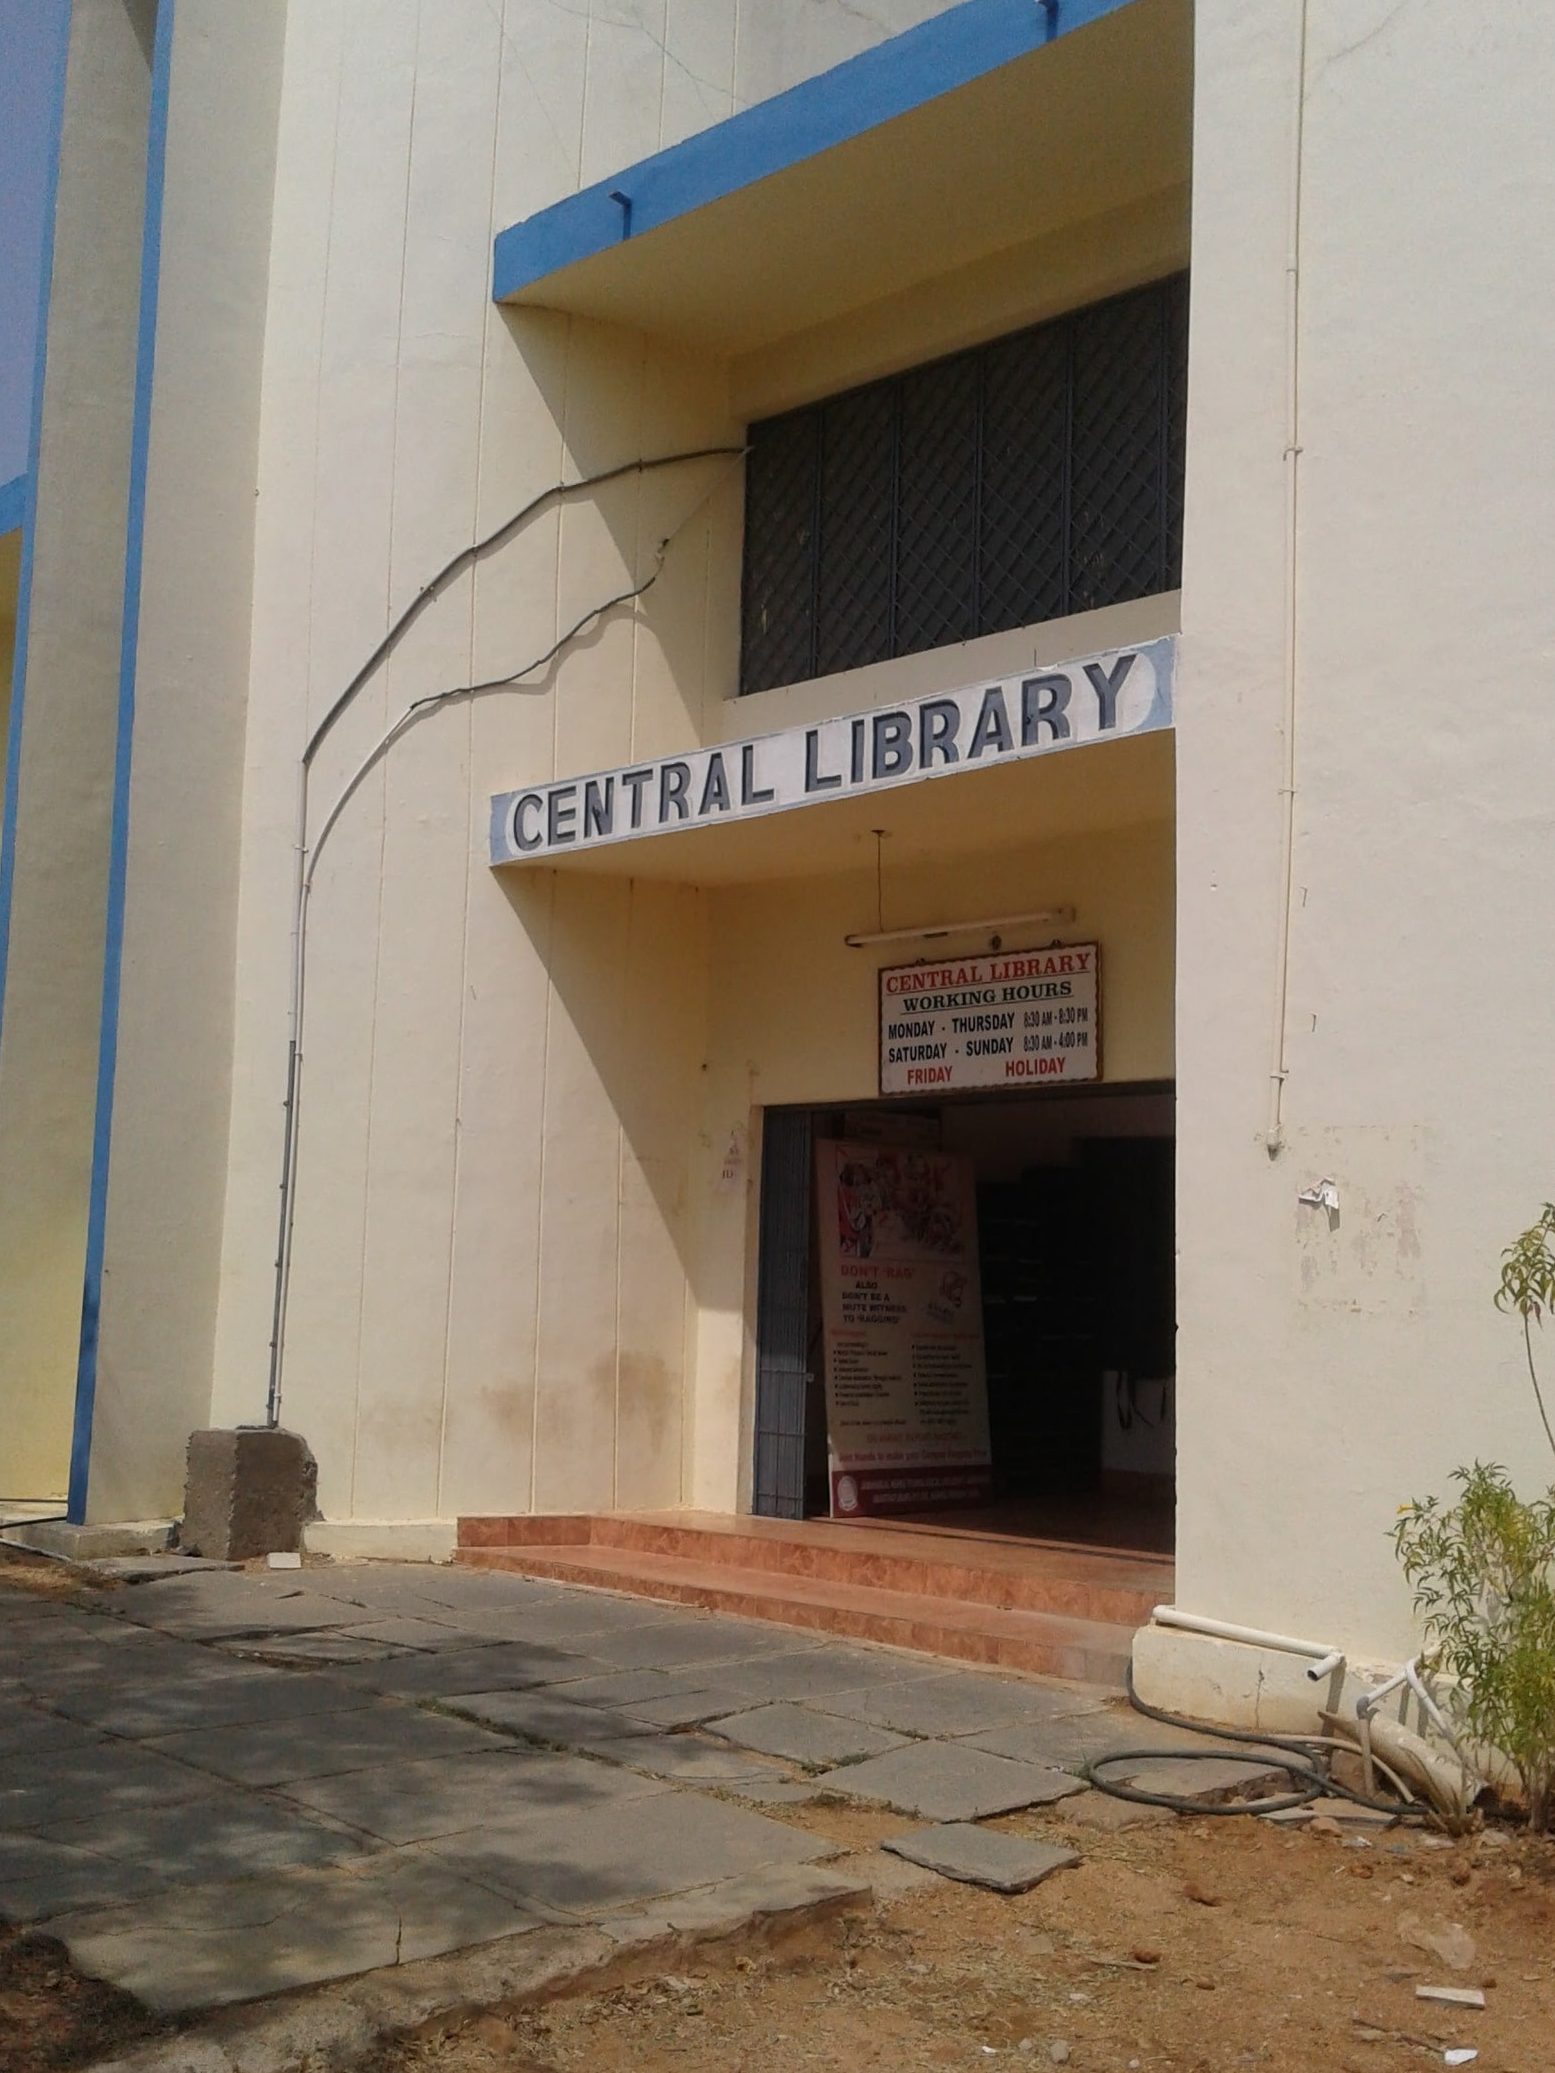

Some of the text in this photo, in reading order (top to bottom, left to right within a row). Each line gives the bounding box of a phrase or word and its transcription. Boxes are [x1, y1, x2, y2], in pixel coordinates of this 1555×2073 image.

[513, 654, 1136, 852] CENTRAL LIBRARY
[886, 953, 1091, 993] CENTRAL LIBRARY
[903, 981, 1072, 1012] WORKING HOURS
[888, 1020, 936, 1040] MONDAY
[952, 1012, 1016, 1034] THURSDAY
[1023, 1011, 1041, 1028] 8:30
[1041, 1010, 1053, 1026] AM
[1077, 1006, 1089, 1022] PM
[888, 1042, 948, 1063] SATURDAY
[966, 1036, 1014, 1057] SUNDAY
[1023, 1034, 1041, 1051] 8:30
[1041, 1033, 1053, 1049] AM
[1058, 1030, 1076, 1048] 4:00
[1077, 1029, 1089, 1046] PM
[907, 1056, 1067, 1086] FRIDAY HOLIDAY
